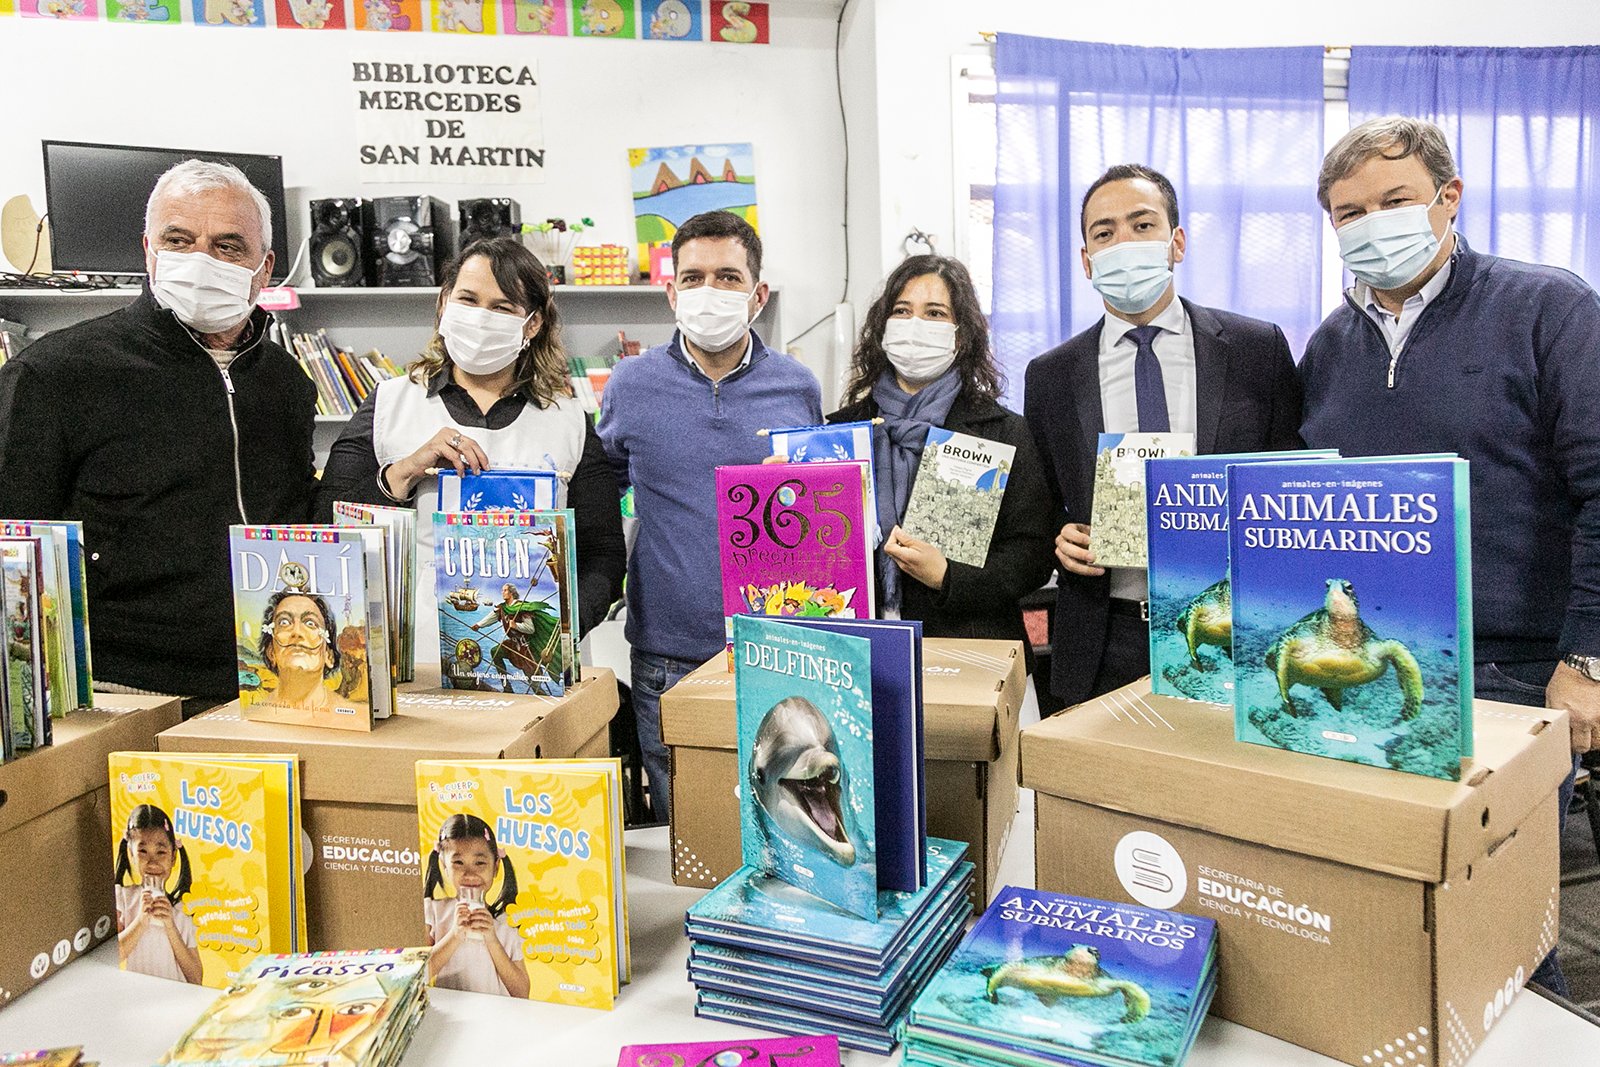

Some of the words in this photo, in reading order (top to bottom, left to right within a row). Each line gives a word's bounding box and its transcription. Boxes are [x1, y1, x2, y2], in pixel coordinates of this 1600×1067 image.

[353, 62, 536, 86] BIBLIOTECA
[359, 90, 521, 113] MERCEDES
[425, 119, 465, 138] DE
[360, 145, 420, 165] SAN
[430, 145, 545, 168] MARTIN
[943, 445, 992, 464] BROWN
[1153, 483, 1228, 507] ANIM
[728, 479, 852, 549] 365
[1237, 493, 1438, 524] ANIMALES
[1245, 527, 1432, 555] SUBMARINOS
[443, 532, 530, 580] COLÓN
[238, 544, 352, 598] DALÍ
[451, 663, 465, 676] Un
[744, 641, 854, 690] DELFINES
[397, 696, 514, 707] DUCACIÓN
[175, 810, 251, 851] HUESOS
[498, 818, 590, 860] HUESOS
[378, 839, 390, 847] DE
[324, 862, 359, 872] CIENCIA
[370, 865, 421, 876] TECNOLOGI
[1268, 885, 1284, 898] DE
[1198, 877, 1331, 932] EDUCACIÓN
[1199, 897, 1242, 917] CIENCIA
[1244, 911, 1252, 920] Y
[1000, 909, 1185, 950] SUBMARINOS
[1001, 896, 1197, 939] ANIMALES
[258, 963, 395, 979] Picasso
